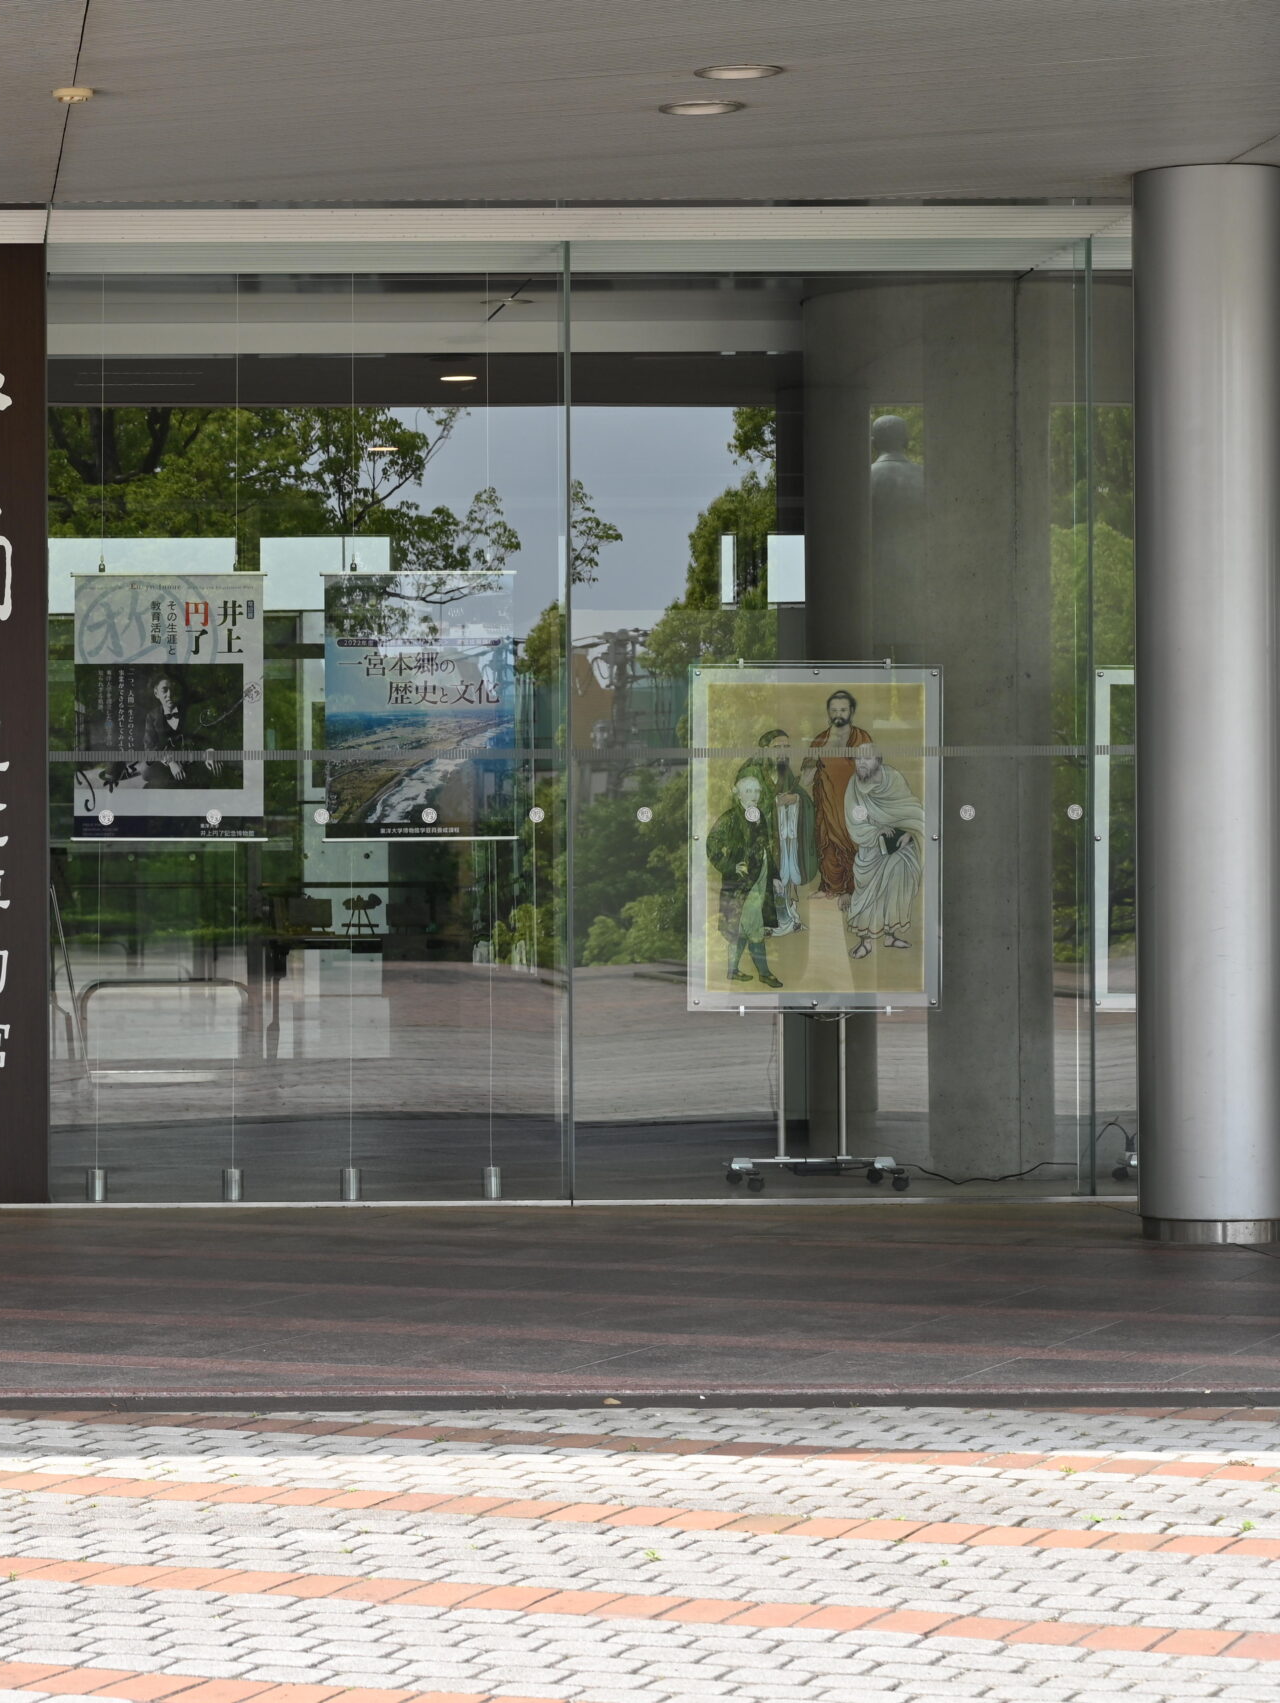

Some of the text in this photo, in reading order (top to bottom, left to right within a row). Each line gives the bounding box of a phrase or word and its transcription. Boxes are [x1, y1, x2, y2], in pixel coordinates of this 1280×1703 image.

[150, 600, 162, 645] 教育活動
[166, 600, 178, 656] その生涯と
[185, 601, 209, 655] 円了
[217, 600, 244, 654] 井上
[338, 651, 455, 677] 一宮本郷の
[387, 680, 500, 705] 歴史と文化
